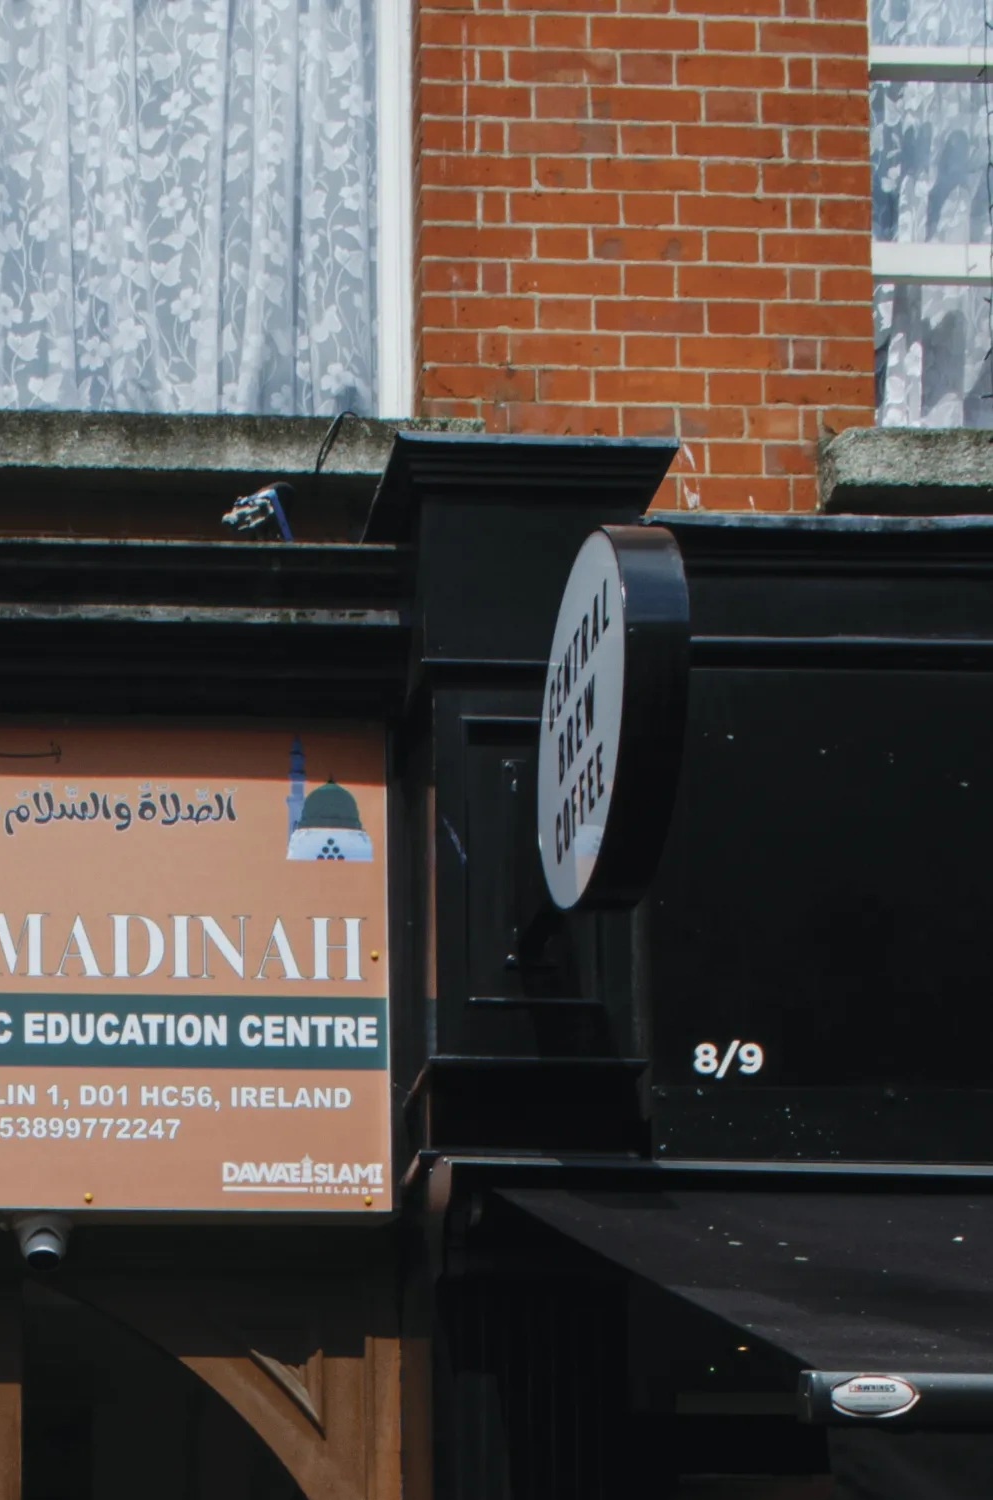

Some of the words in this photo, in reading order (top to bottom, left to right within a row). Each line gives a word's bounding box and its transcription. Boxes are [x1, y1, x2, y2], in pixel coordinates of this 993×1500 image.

[548, 578, 610, 733] CENTRAL
[558, 674, 595, 786] BREW
[555, 741, 605, 865] COFFEE
[23, 1012, 228, 1047] EDUCATION
[239, 1015, 378, 1048] CENTRE
[692, 1039, 764, 1079] 8/9
[46, 1085, 69, 1110] 1,
[79, 1085, 129, 1107] D01
[140, 1086, 221, 1111] HC56,
[230, 1086, 351, 1109] IRELAND
[309, 1186, 369, 1195] IRELAND
